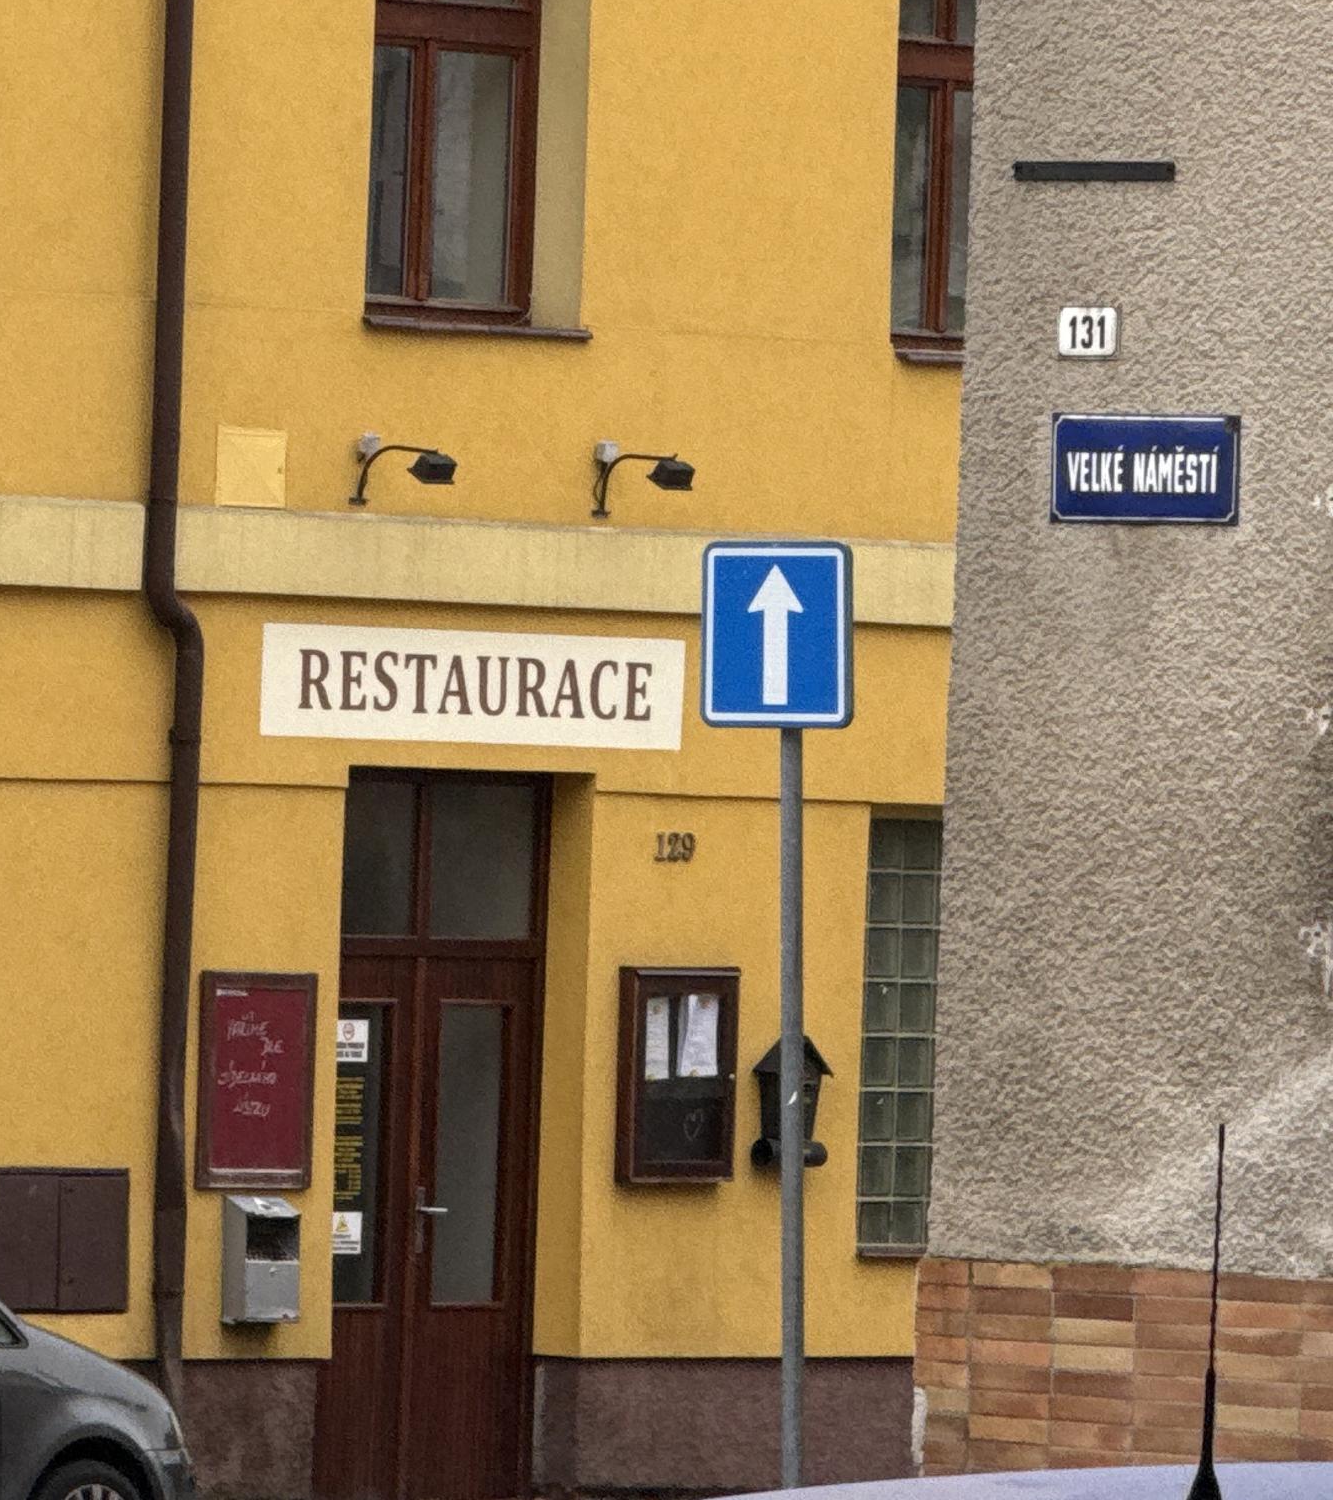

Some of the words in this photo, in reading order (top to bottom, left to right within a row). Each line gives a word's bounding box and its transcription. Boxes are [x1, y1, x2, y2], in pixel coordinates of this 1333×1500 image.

[1068, 315, 1107, 350] 131
[1066, 445, 1125, 493] VELKÉ
[1132, 445, 1219, 494] NÁMĚSTÍ
[298, 649, 654, 722] RESTAURACE
[653, 831, 697, 863] 129
